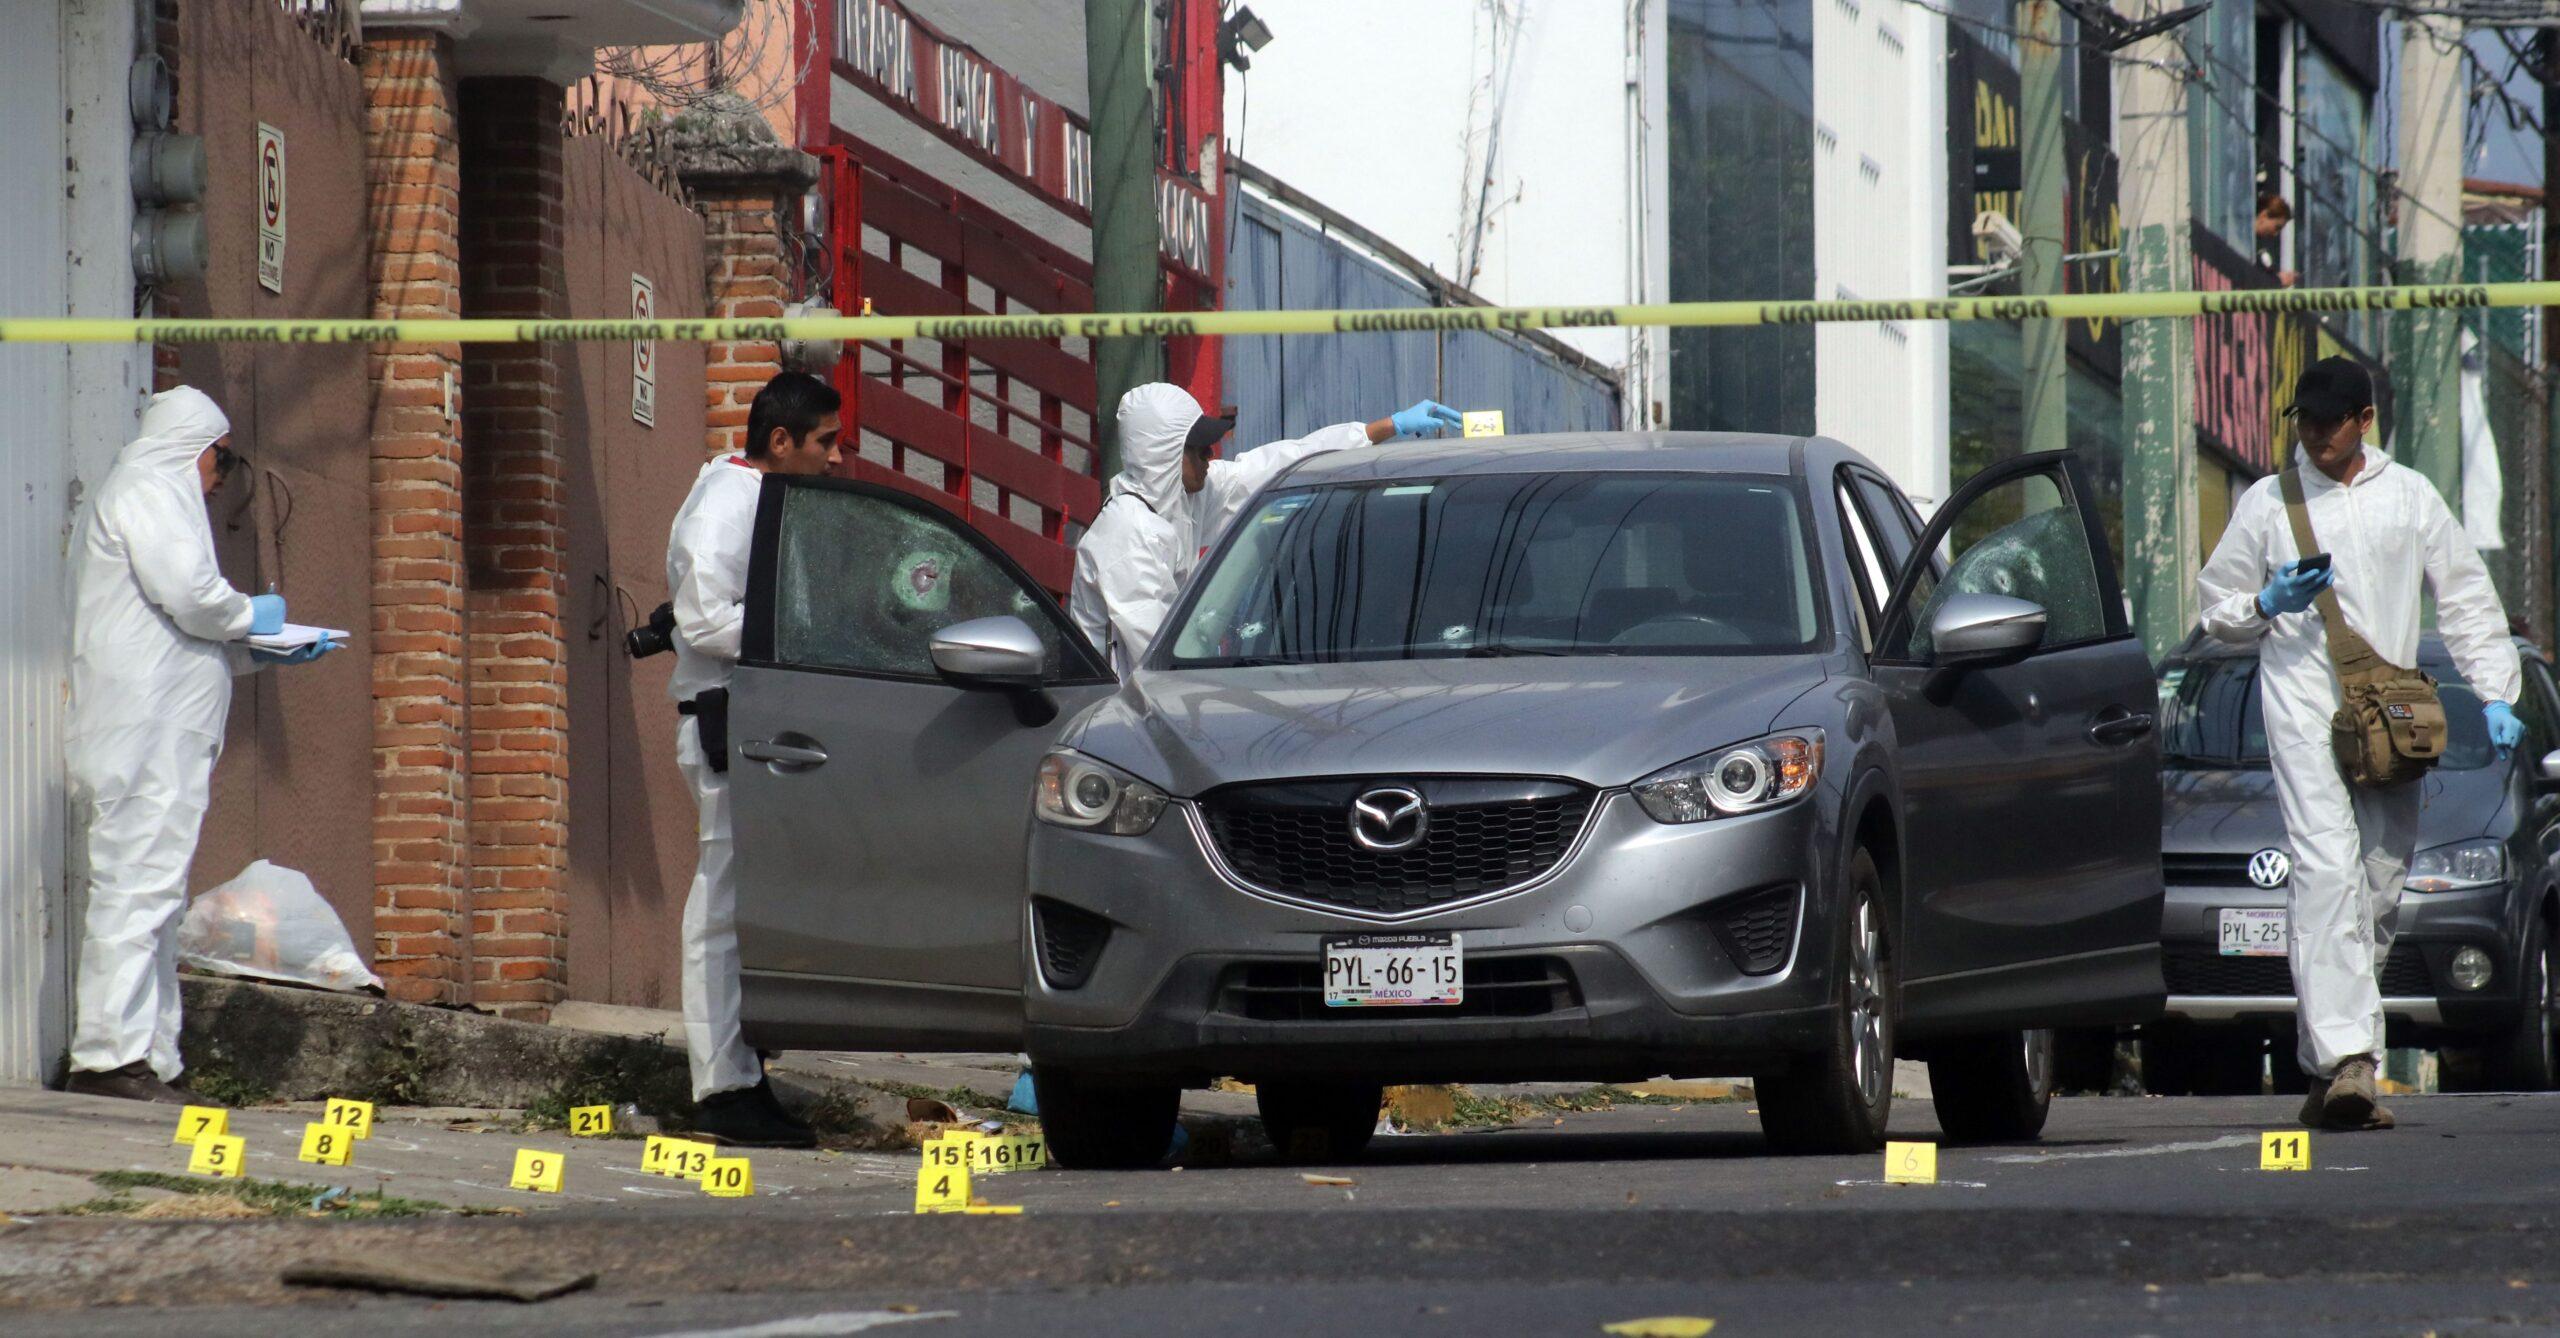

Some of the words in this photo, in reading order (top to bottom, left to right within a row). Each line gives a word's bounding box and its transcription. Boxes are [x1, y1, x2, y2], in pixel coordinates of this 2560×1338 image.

[1021, 95, 1037, 178] Y
[264, 239, 275, 263] NO
[1328, 956, 1457, 987] PYL-66-15
[1329, 992, 1338, 1000] 17
[1374, 988, 1413, 998] MÉXICO
[195, 1117, 211, 1134] 7
[332, 1105, 362, 1127] 12
[578, 1112, 604, 1131] 21
[209, 1144, 226, 1165] 5
[316, 1134, 333, 1155] 8
[650, 1142, 670, 1162] 1
[980, 1145, 1010, 1164] 16
[1014, 1142, 1041, 1163] 17
[2269, 1138, 2298, 1158] 11
[676, 1150, 706, 1173] 13
[930, 1146, 959, 1165] 15
[1904, 1147, 1918, 1171] 6
[529, 1159, 545, 1179] 9
[711, 1166, 742, 1188] 10
[933, 1175, 951, 1198] 4
